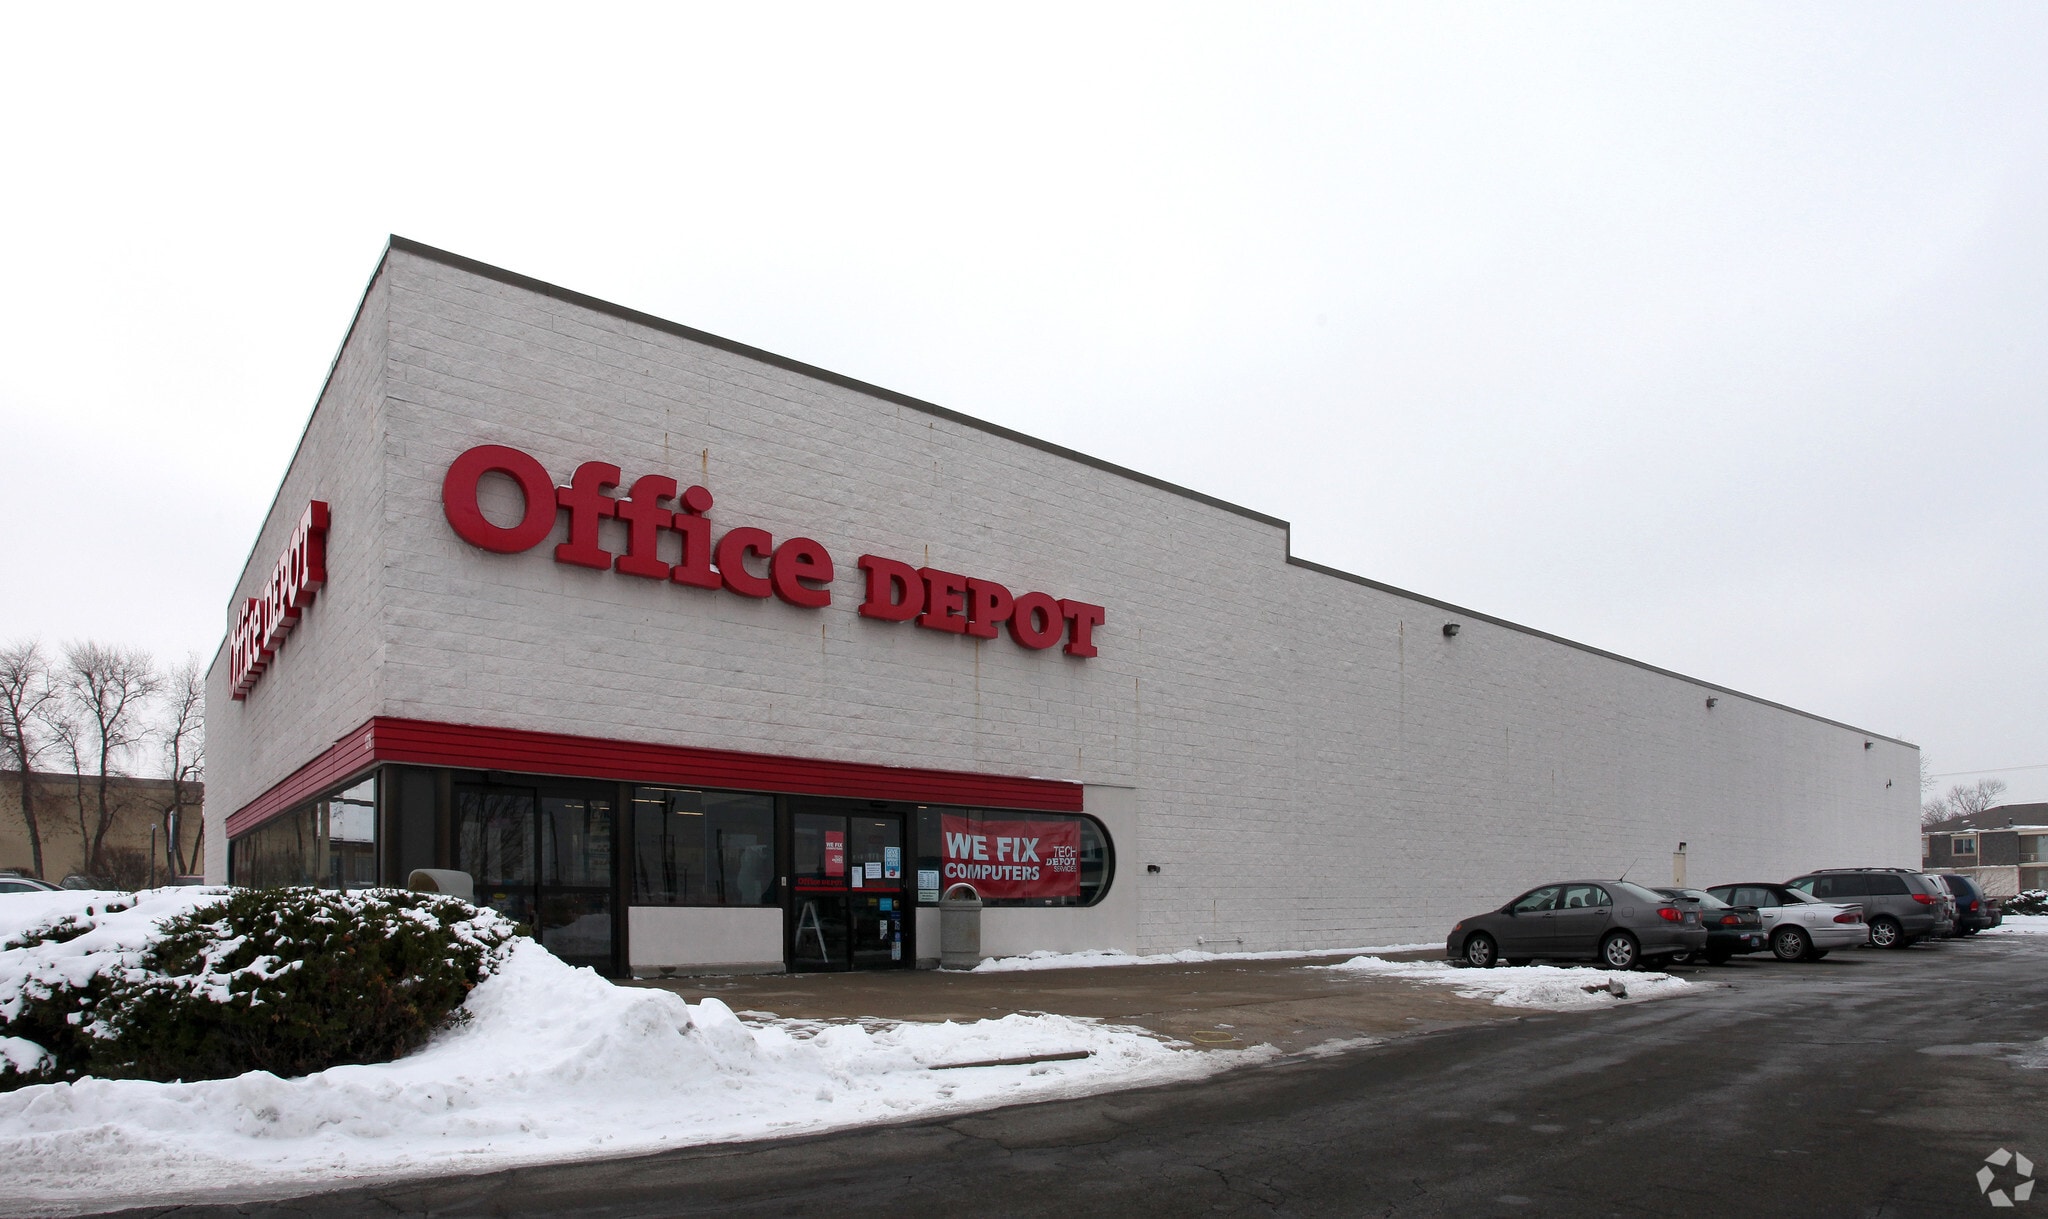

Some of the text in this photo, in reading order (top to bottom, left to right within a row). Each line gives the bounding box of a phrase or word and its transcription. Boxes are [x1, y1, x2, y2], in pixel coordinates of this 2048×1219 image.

[442, 444, 1105, 657] Office DEPOT
[229, 500, 321, 700] Office DEPOT
[945, 831, 1041, 863] WE FIX
[1052, 845, 1077, 859] TECH
[944, 862, 1040, 881] COMPUTERS
[1045, 858, 1077, 866] DEPOT
